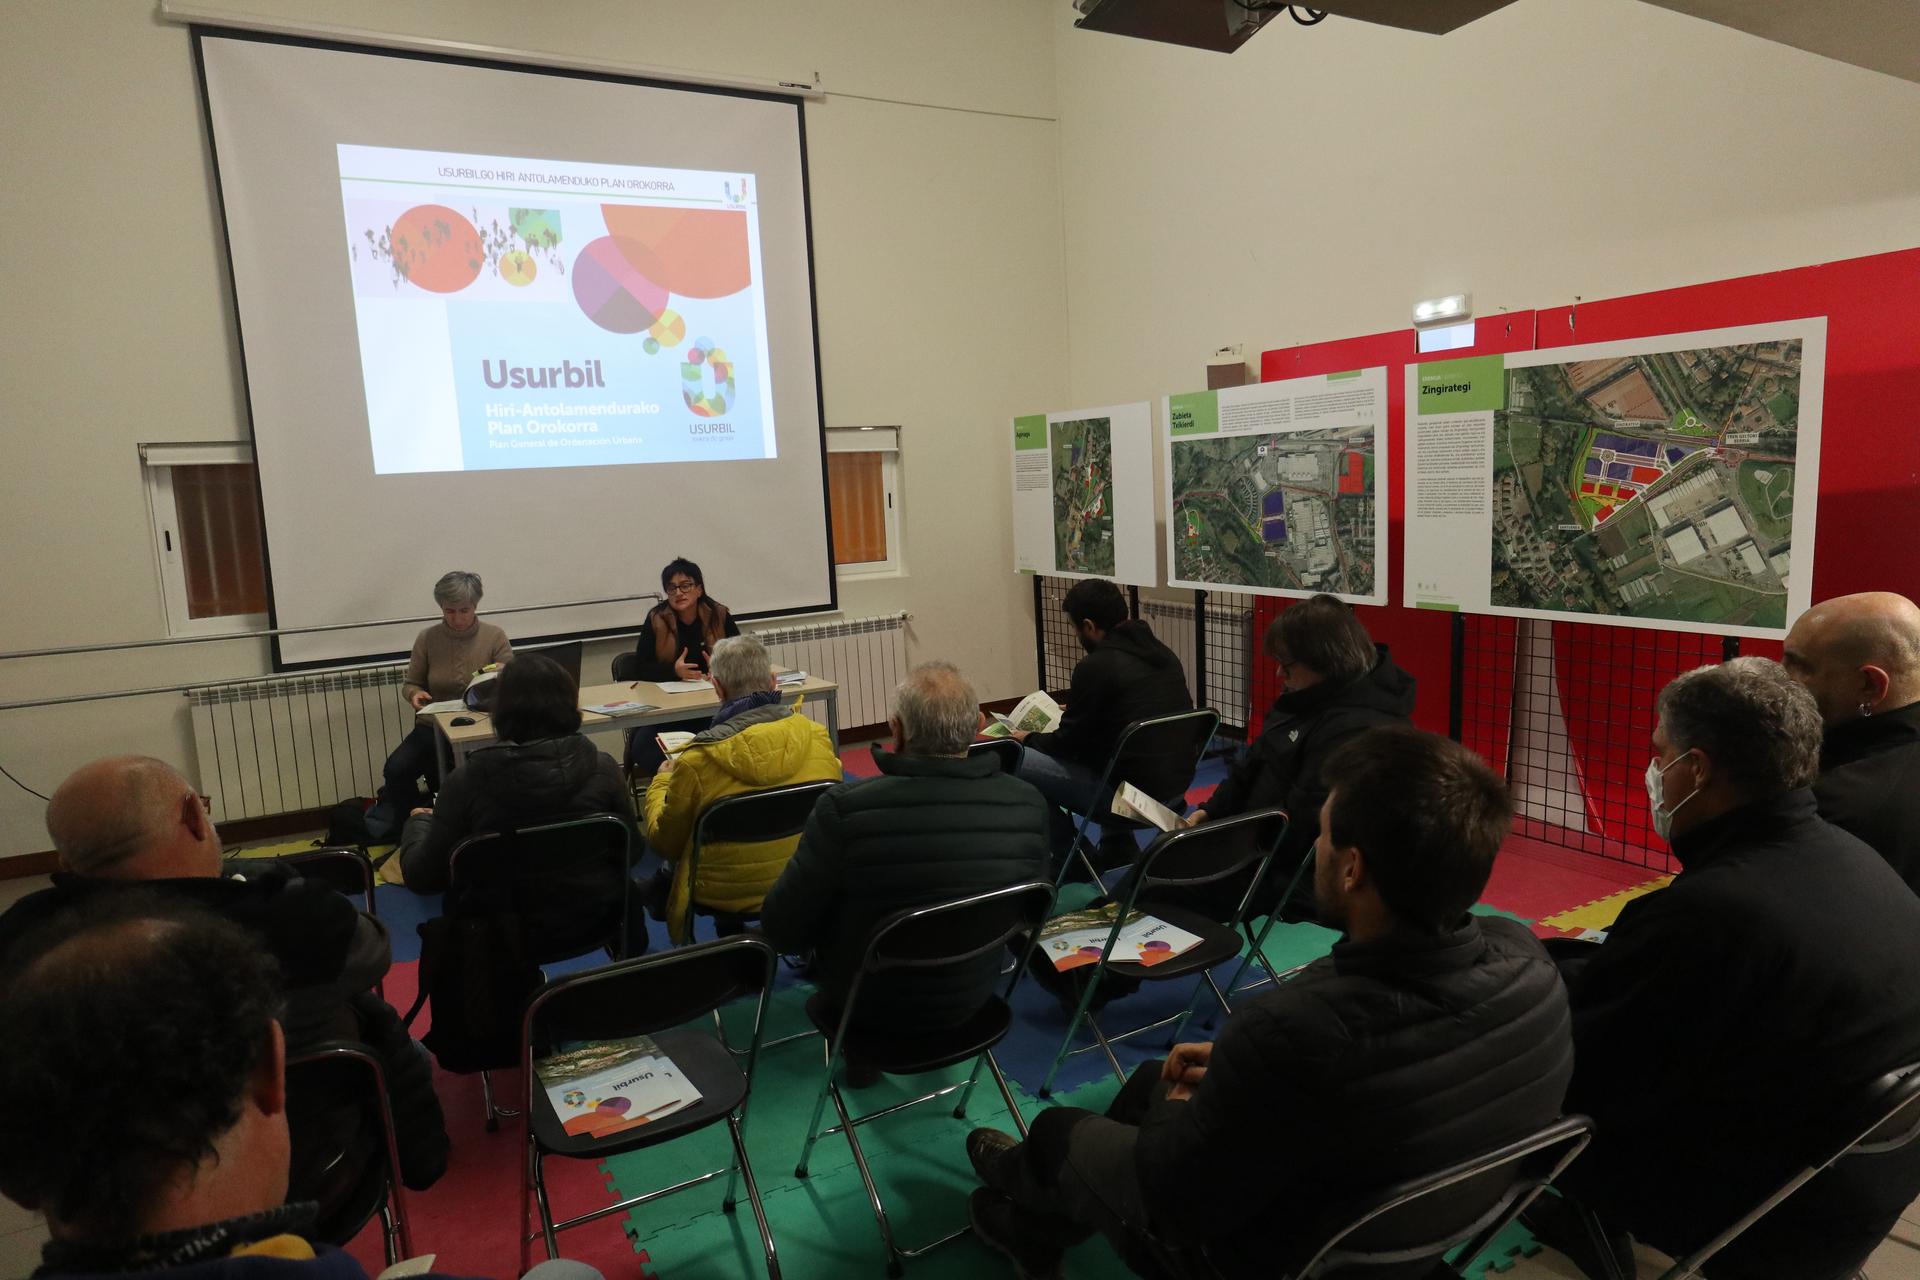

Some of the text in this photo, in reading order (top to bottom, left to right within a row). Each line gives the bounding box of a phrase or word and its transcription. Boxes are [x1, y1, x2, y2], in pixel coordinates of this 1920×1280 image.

[438, 167, 675, 192] USURBILGO HIRI ANTOLAMENDUKO PLAN OROKORRA
[482, 359, 606, 389] Usurbil
[1422, 380, 1471, 396] Zingirategi
[485, 401, 660, 417] Hiri-Antolamendurako
[487, 419, 599, 435] Plan Orokorra
[689, 423, 736, 434] USURBIL
[489, 439, 509, 449] Plan
[1141, 924, 1167, 939] Usurbil
[612, 1072, 654, 1091] Usurbil
